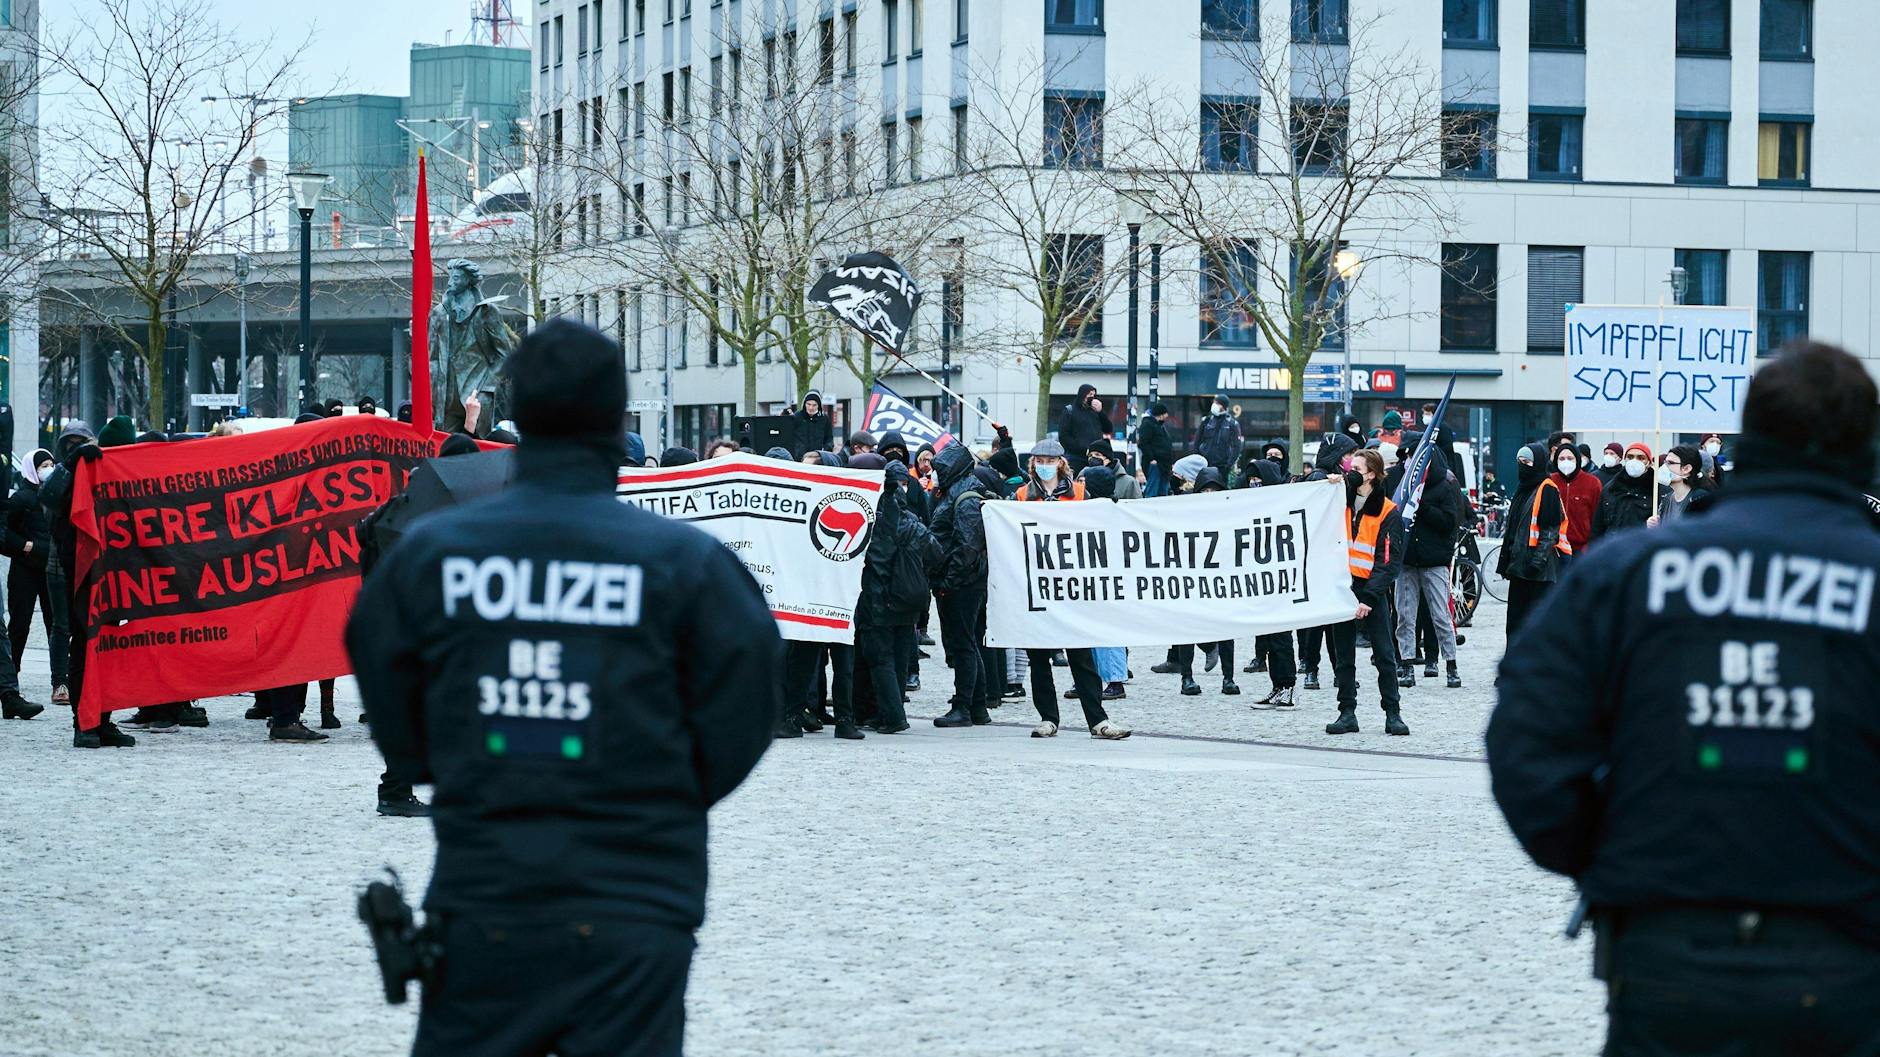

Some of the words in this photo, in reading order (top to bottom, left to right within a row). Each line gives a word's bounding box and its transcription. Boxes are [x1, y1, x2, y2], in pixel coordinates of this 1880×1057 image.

[1569, 322, 1753, 365] IMPFPFLICHT
[1217, 368, 1370, 391] MEINR
[1574, 366, 1753, 412] SOFORT
[164, 470, 214, 493] GEGEN
[312, 438, 341, 463] UND
[705, 488, 807, 515] Tabletten
[197, 522, 362, 600] AUSLÄN
[820, 548, 850, 561] AKTION
[1033, 530, 1109, 570] KEIN
[1121, 531, 1221, 569] PLATZ
[1234, 517, 1297, 568] FÜR
[442, 556, 643, 626] POLIZEI
[1038, 576, 1125, 601] RECHTE
[1136, 567, 1298, 600] PROPAGANDA!
[1648, 547, 1875, 634] POLIZEI
[778, 602, 806, 613] Hunden
[807, 607, 817, 615] ab
[825, 609, 851, 620] Jahren
[180, 626, 227, 645] Fichte
[509, 638, 562, 680] BE
[1721, 640, 1780, 685] BE
[478, 675, 591, 721] 31125
[1686, 682, 1815, 731] 31123
